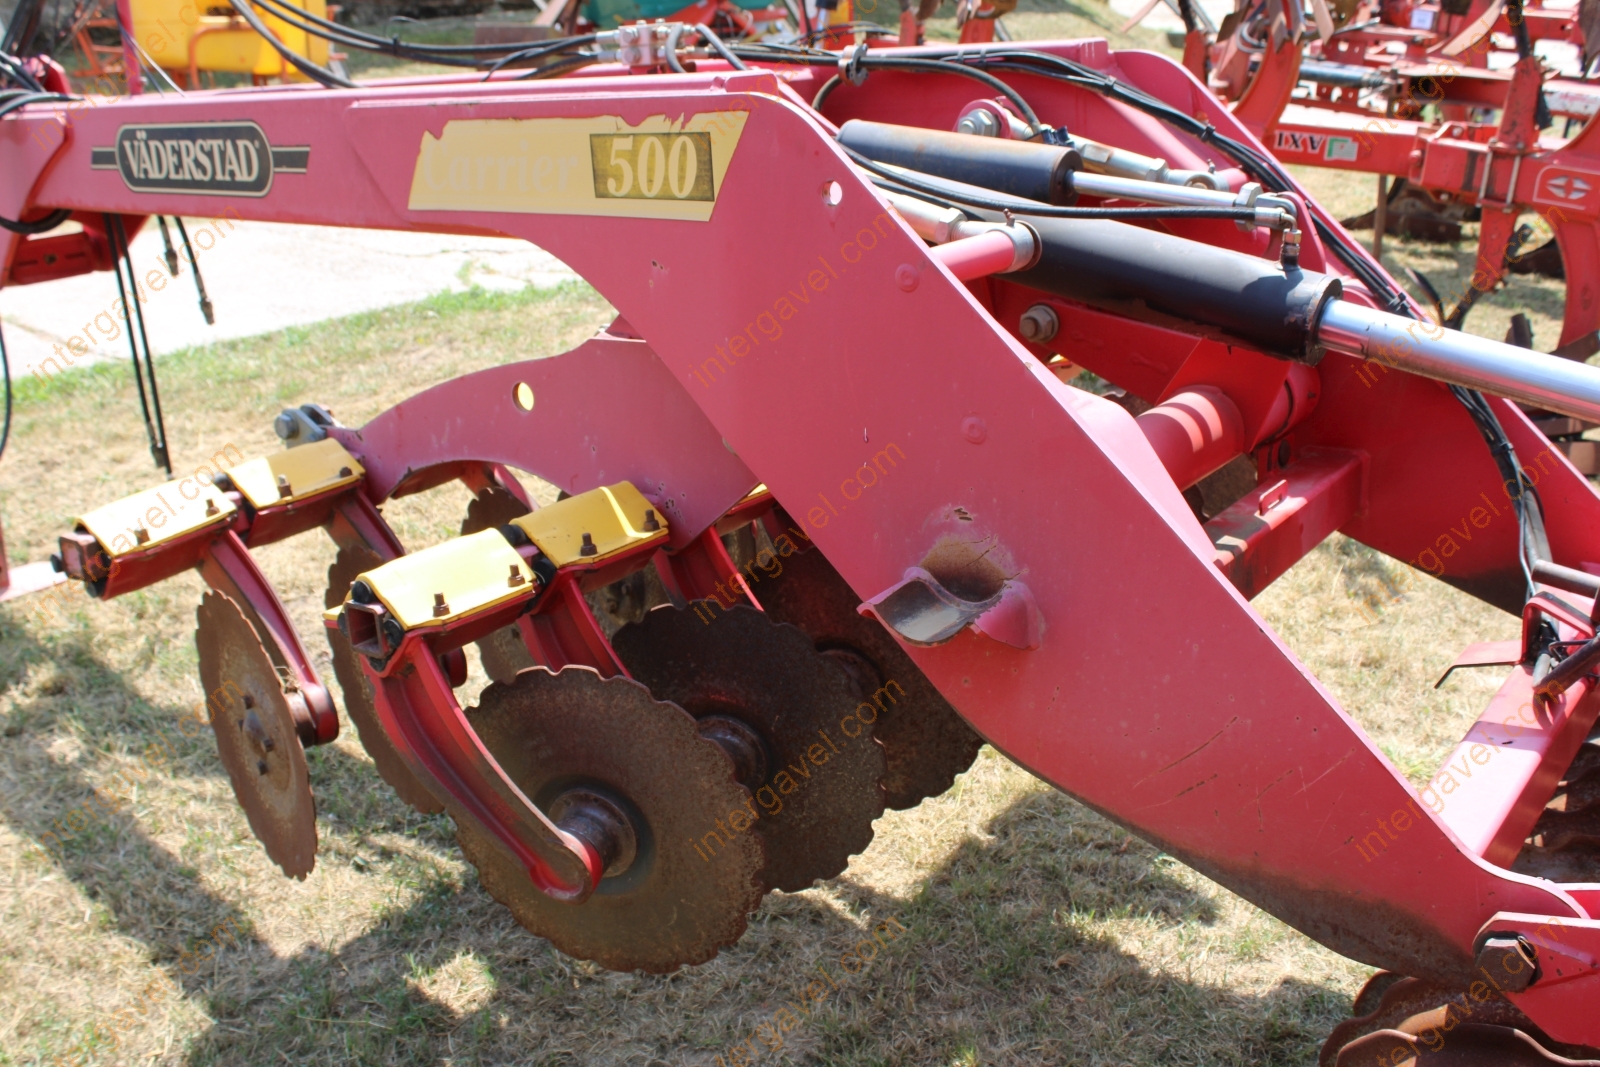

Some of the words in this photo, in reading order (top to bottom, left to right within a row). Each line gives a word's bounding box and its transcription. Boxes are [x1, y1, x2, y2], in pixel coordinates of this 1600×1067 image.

[122, 129, 260, 182] VÄDERSTAD
[423, 138, 579, 194] Carrier
[606, 135, 698, 199] 500
